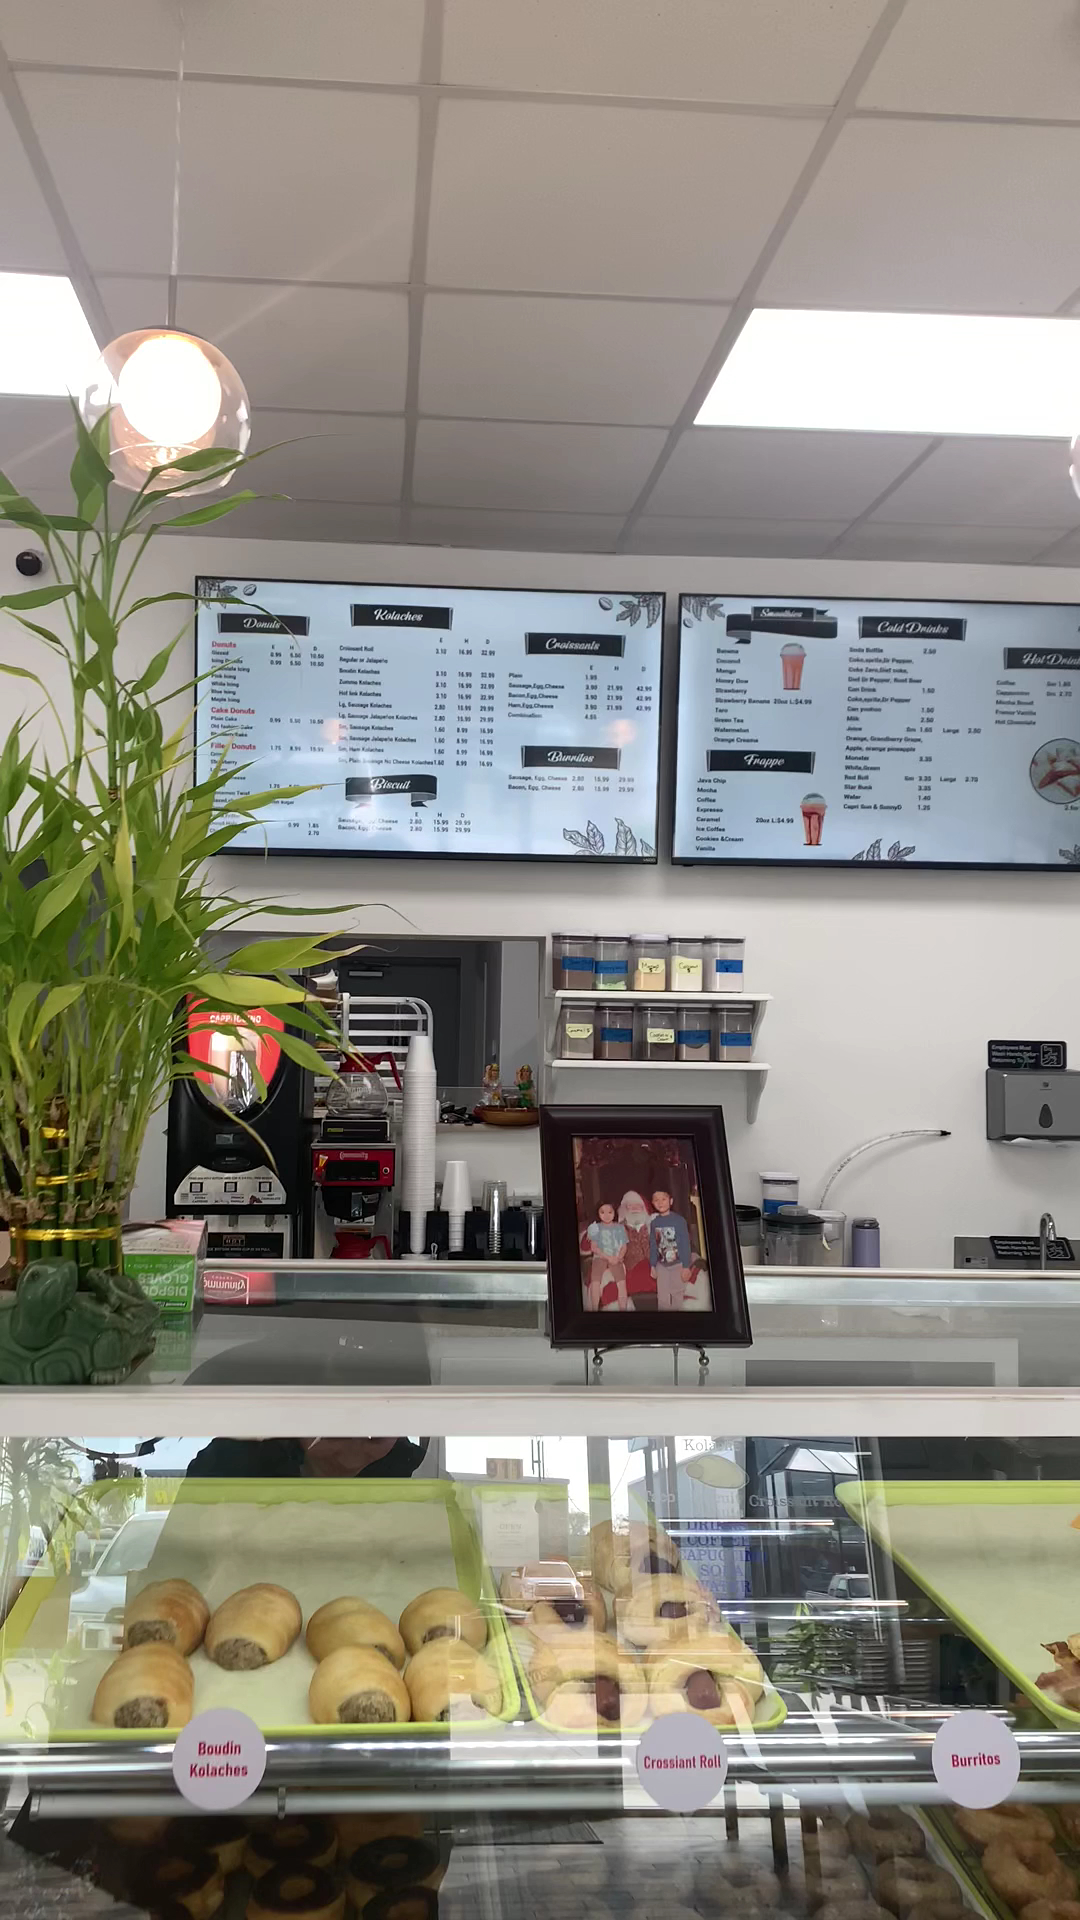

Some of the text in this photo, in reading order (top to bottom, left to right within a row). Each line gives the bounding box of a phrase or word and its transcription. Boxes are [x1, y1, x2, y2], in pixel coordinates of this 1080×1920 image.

[374, 609, 423, 622] Kolaches
[243, 617, 281, 629] Donuts
[877, 621, 949, 634] Cold Drinks
[546, 638, 600, 651] Croissants
[1023, 653, 1046, 664] Hot
[548, 751, 595, 763] Burritos
[744, 753, 785, 768] Frappe
[370, 778, 411, 790] Biscuit
[198, 1740, 241, 1756] Boudin
[643, 1754, 721, 1770] Crossiant Roll
[951, 1752, 1001, 1768] Burritos
[190, 1763, 248, 1778] Kolaches
